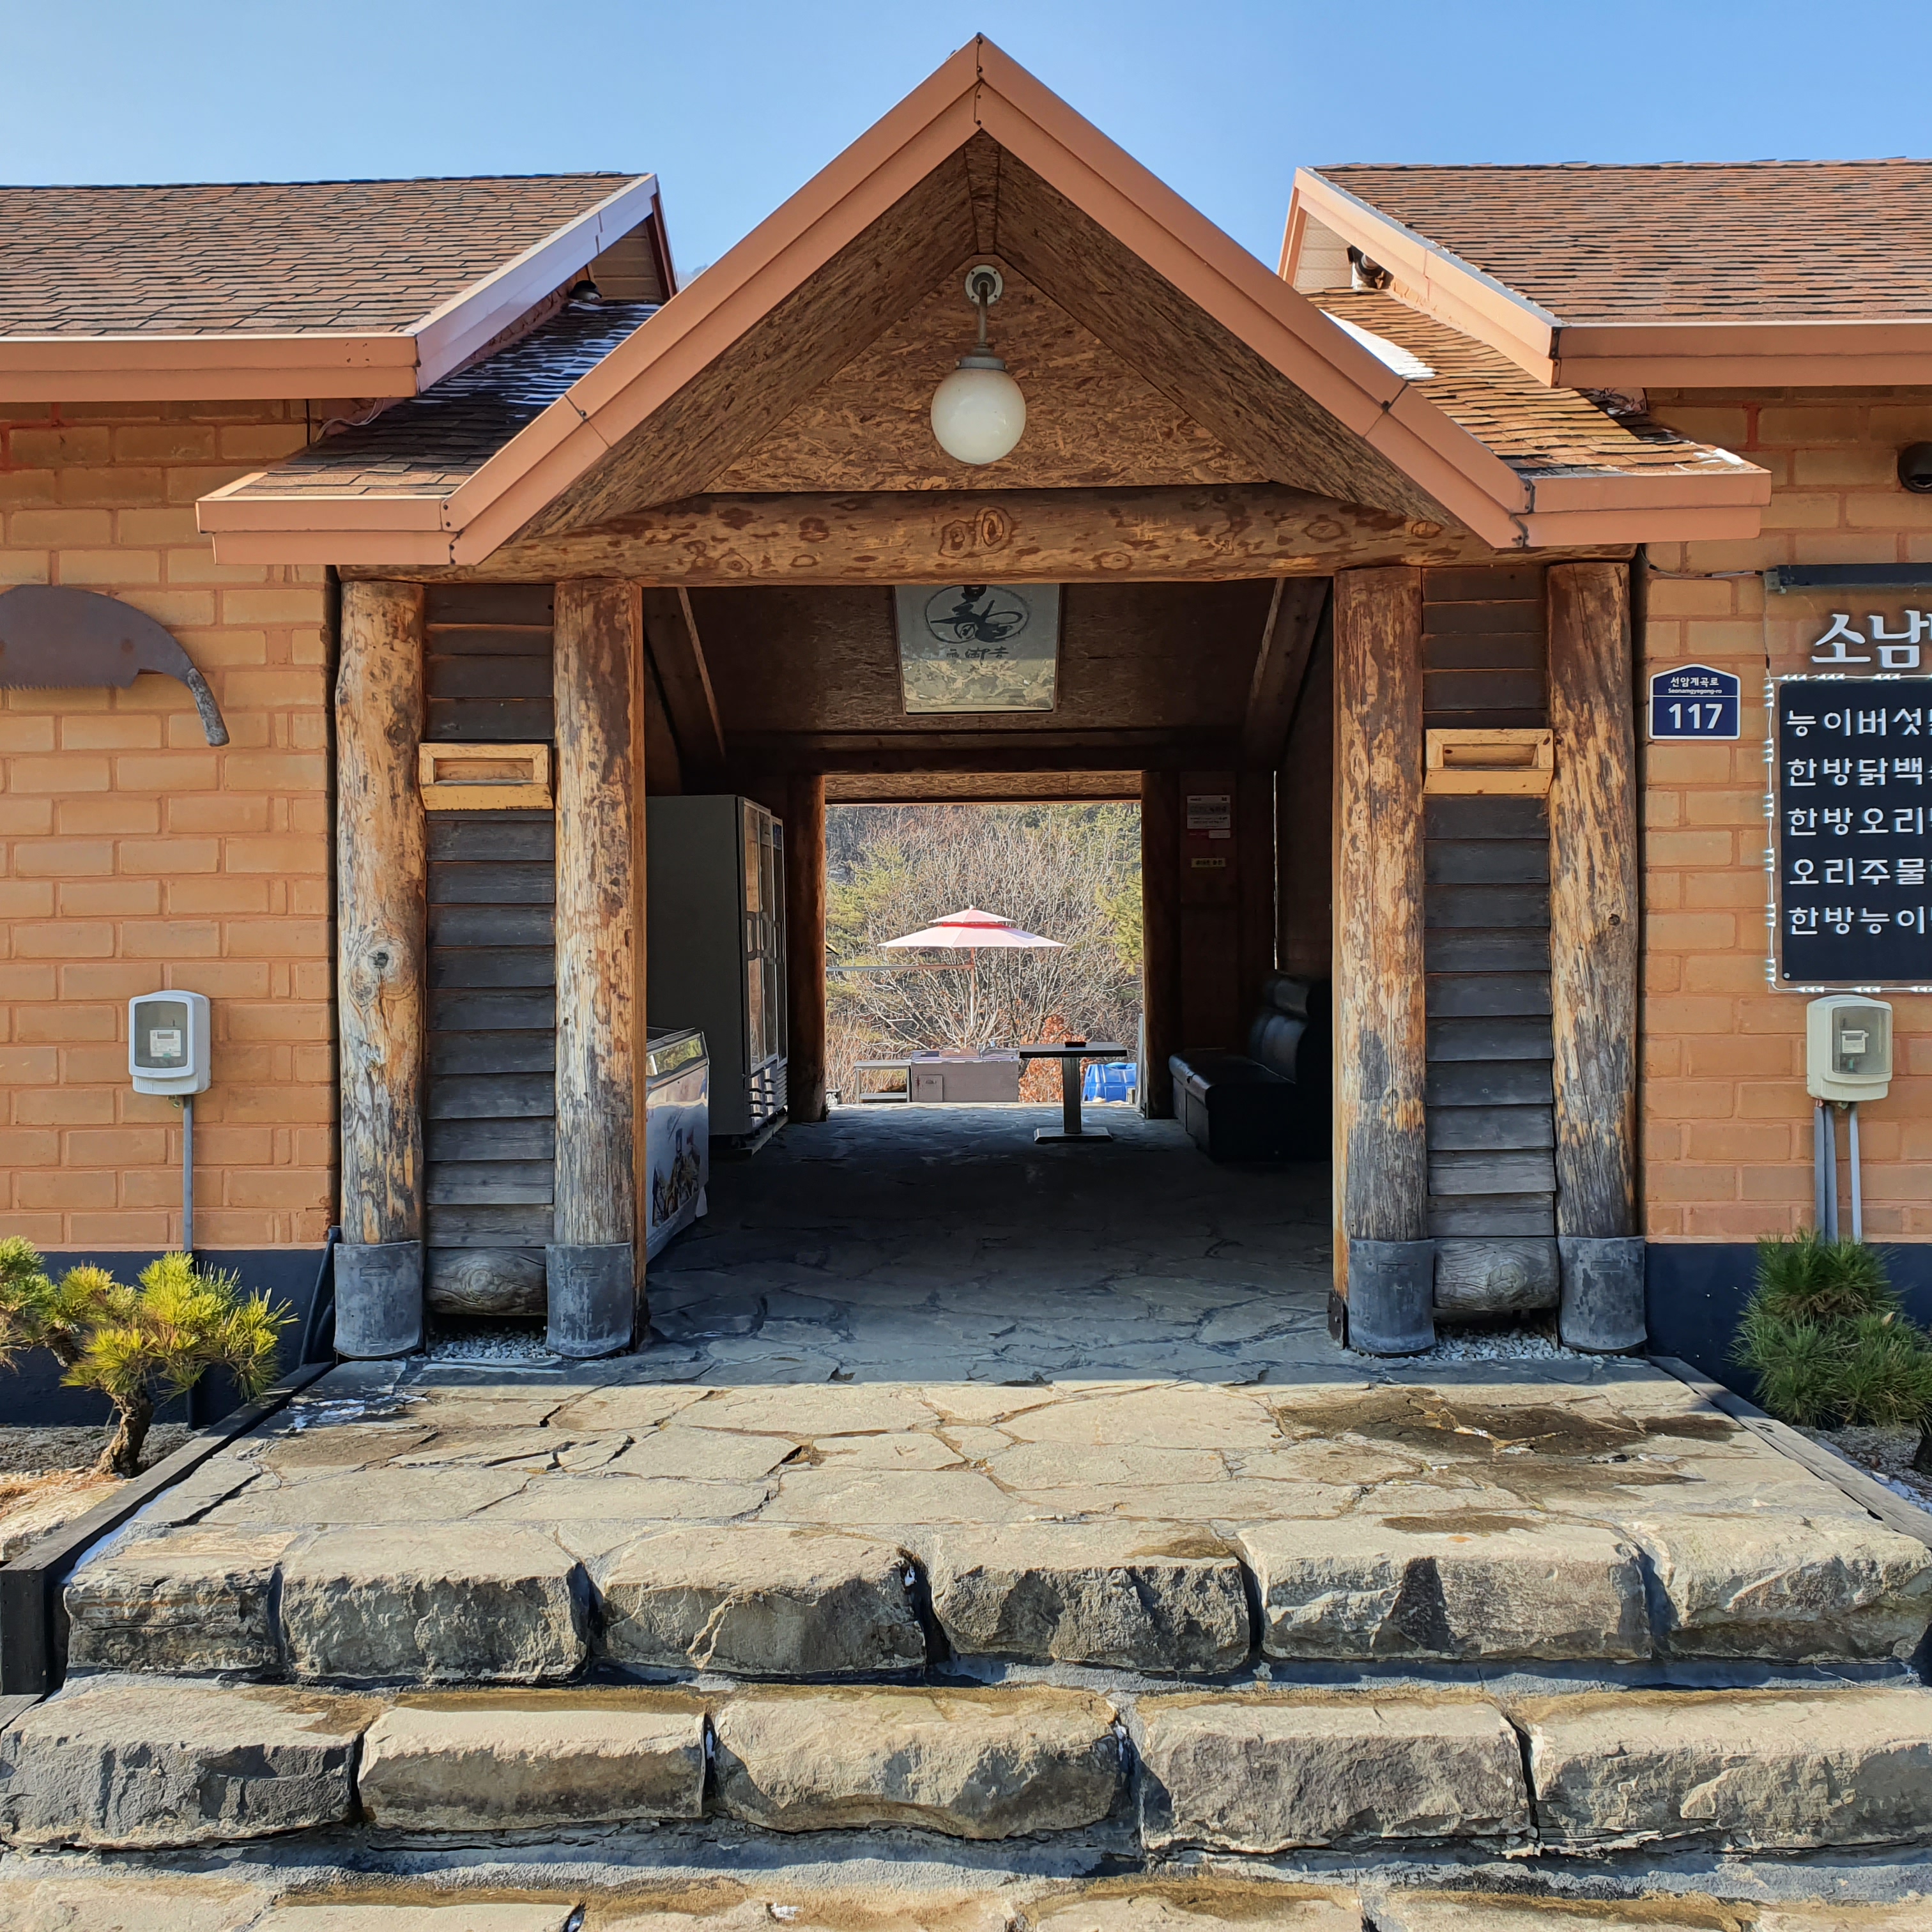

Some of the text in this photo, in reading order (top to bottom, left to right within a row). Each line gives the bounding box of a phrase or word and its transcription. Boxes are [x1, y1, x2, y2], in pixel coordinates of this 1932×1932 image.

[1811, 610, 1932, 668] 소남
[1670, 676, 1719, 687] 선암계곡로
[1668, 703, 1722, 729] 117
[1786, 708, 1932, 737] 능이버섯
[1787, 757, 1932, 786] 한방닭백
[1787, 806, 1932, 836] 한방오리
[1789, 857, 1932, 885] 오리주물
[1788, 906, 1932, 935] 한방능이
